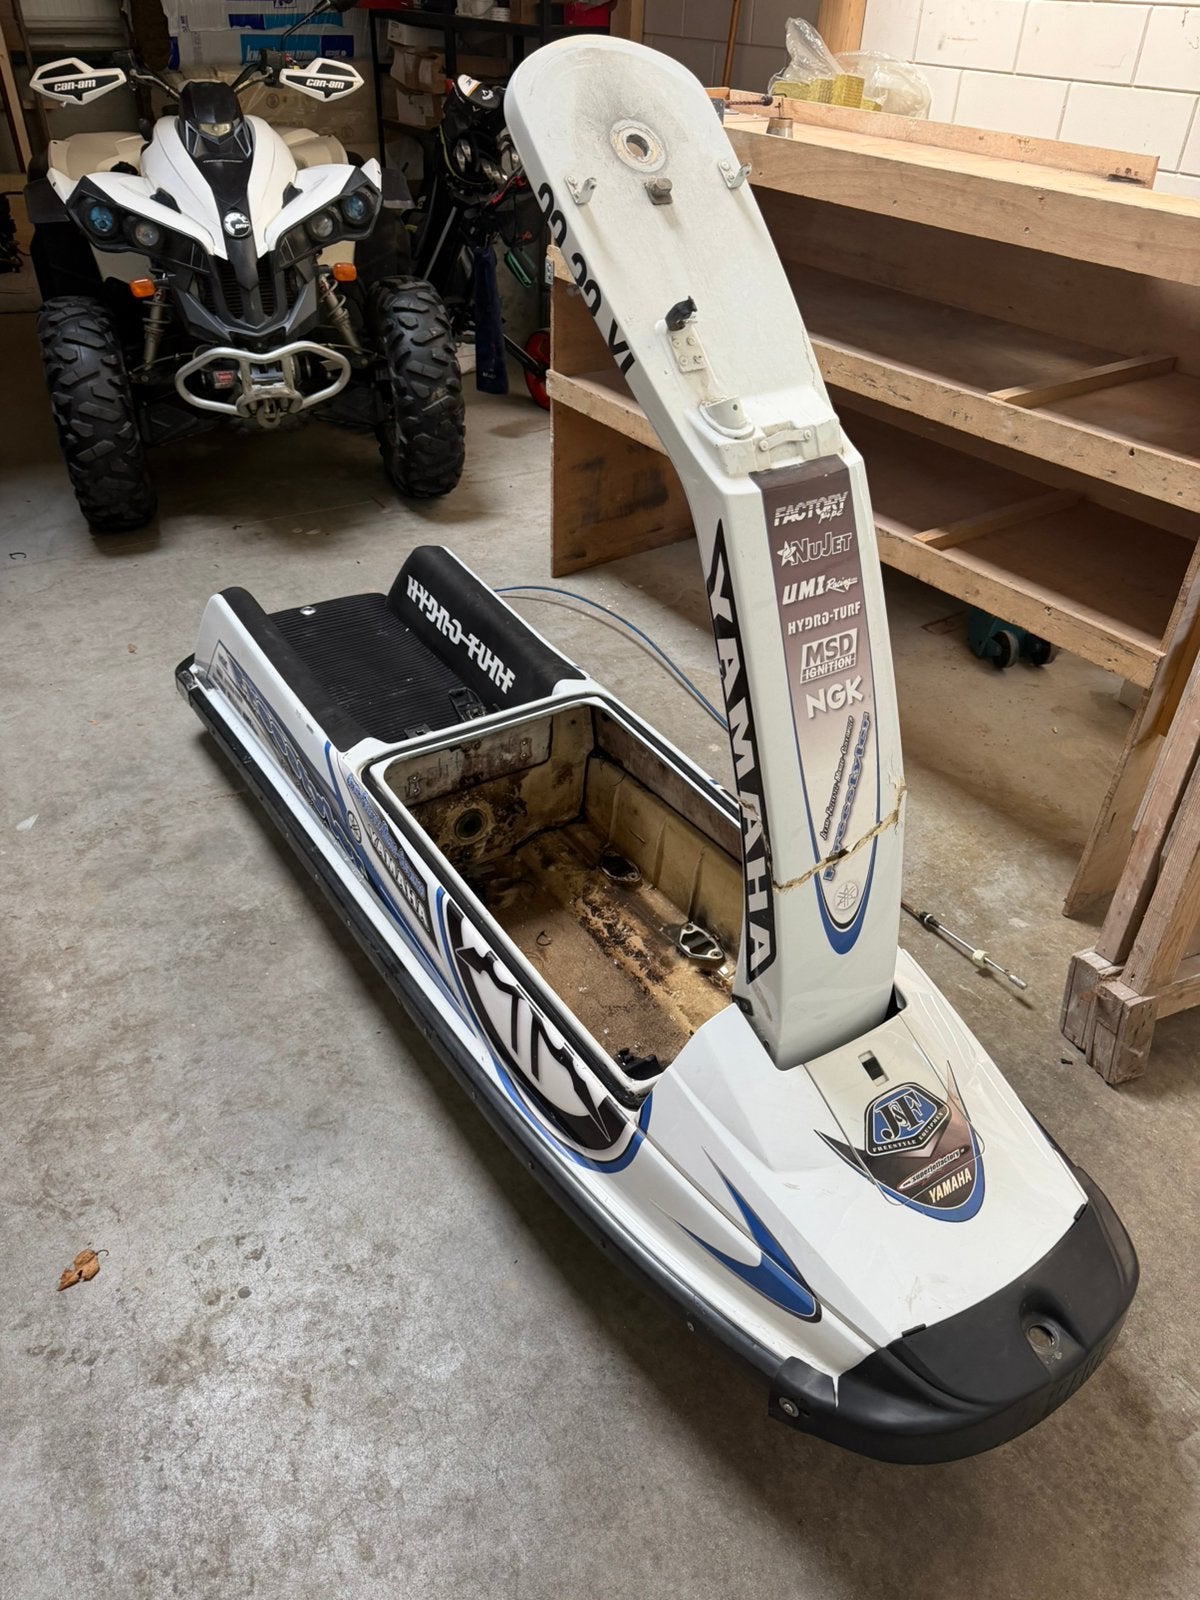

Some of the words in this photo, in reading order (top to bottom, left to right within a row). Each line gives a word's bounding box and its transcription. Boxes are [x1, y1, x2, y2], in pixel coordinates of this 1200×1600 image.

[54, 79, 96, 91] can-am
[306, 78, 345, 89] can-am
[773, 491, 848, 527] FACTORY
[782, 575, 826, 606] UMI
[407, 574, 516, 694] HYDRO-TURF
[788, 601, 861, 636] HYDRO-TURF
[804, 655, 852, 680] IGNITION
[805, 632, 855, 668] MSD
[806, 676, 864, 719] NGK
[710, 551, 771, 971] YAMAHA
[872, 1139, 917, 1153] FREESTYLE
[929, 1167, 972, 1203] YAMAHA
